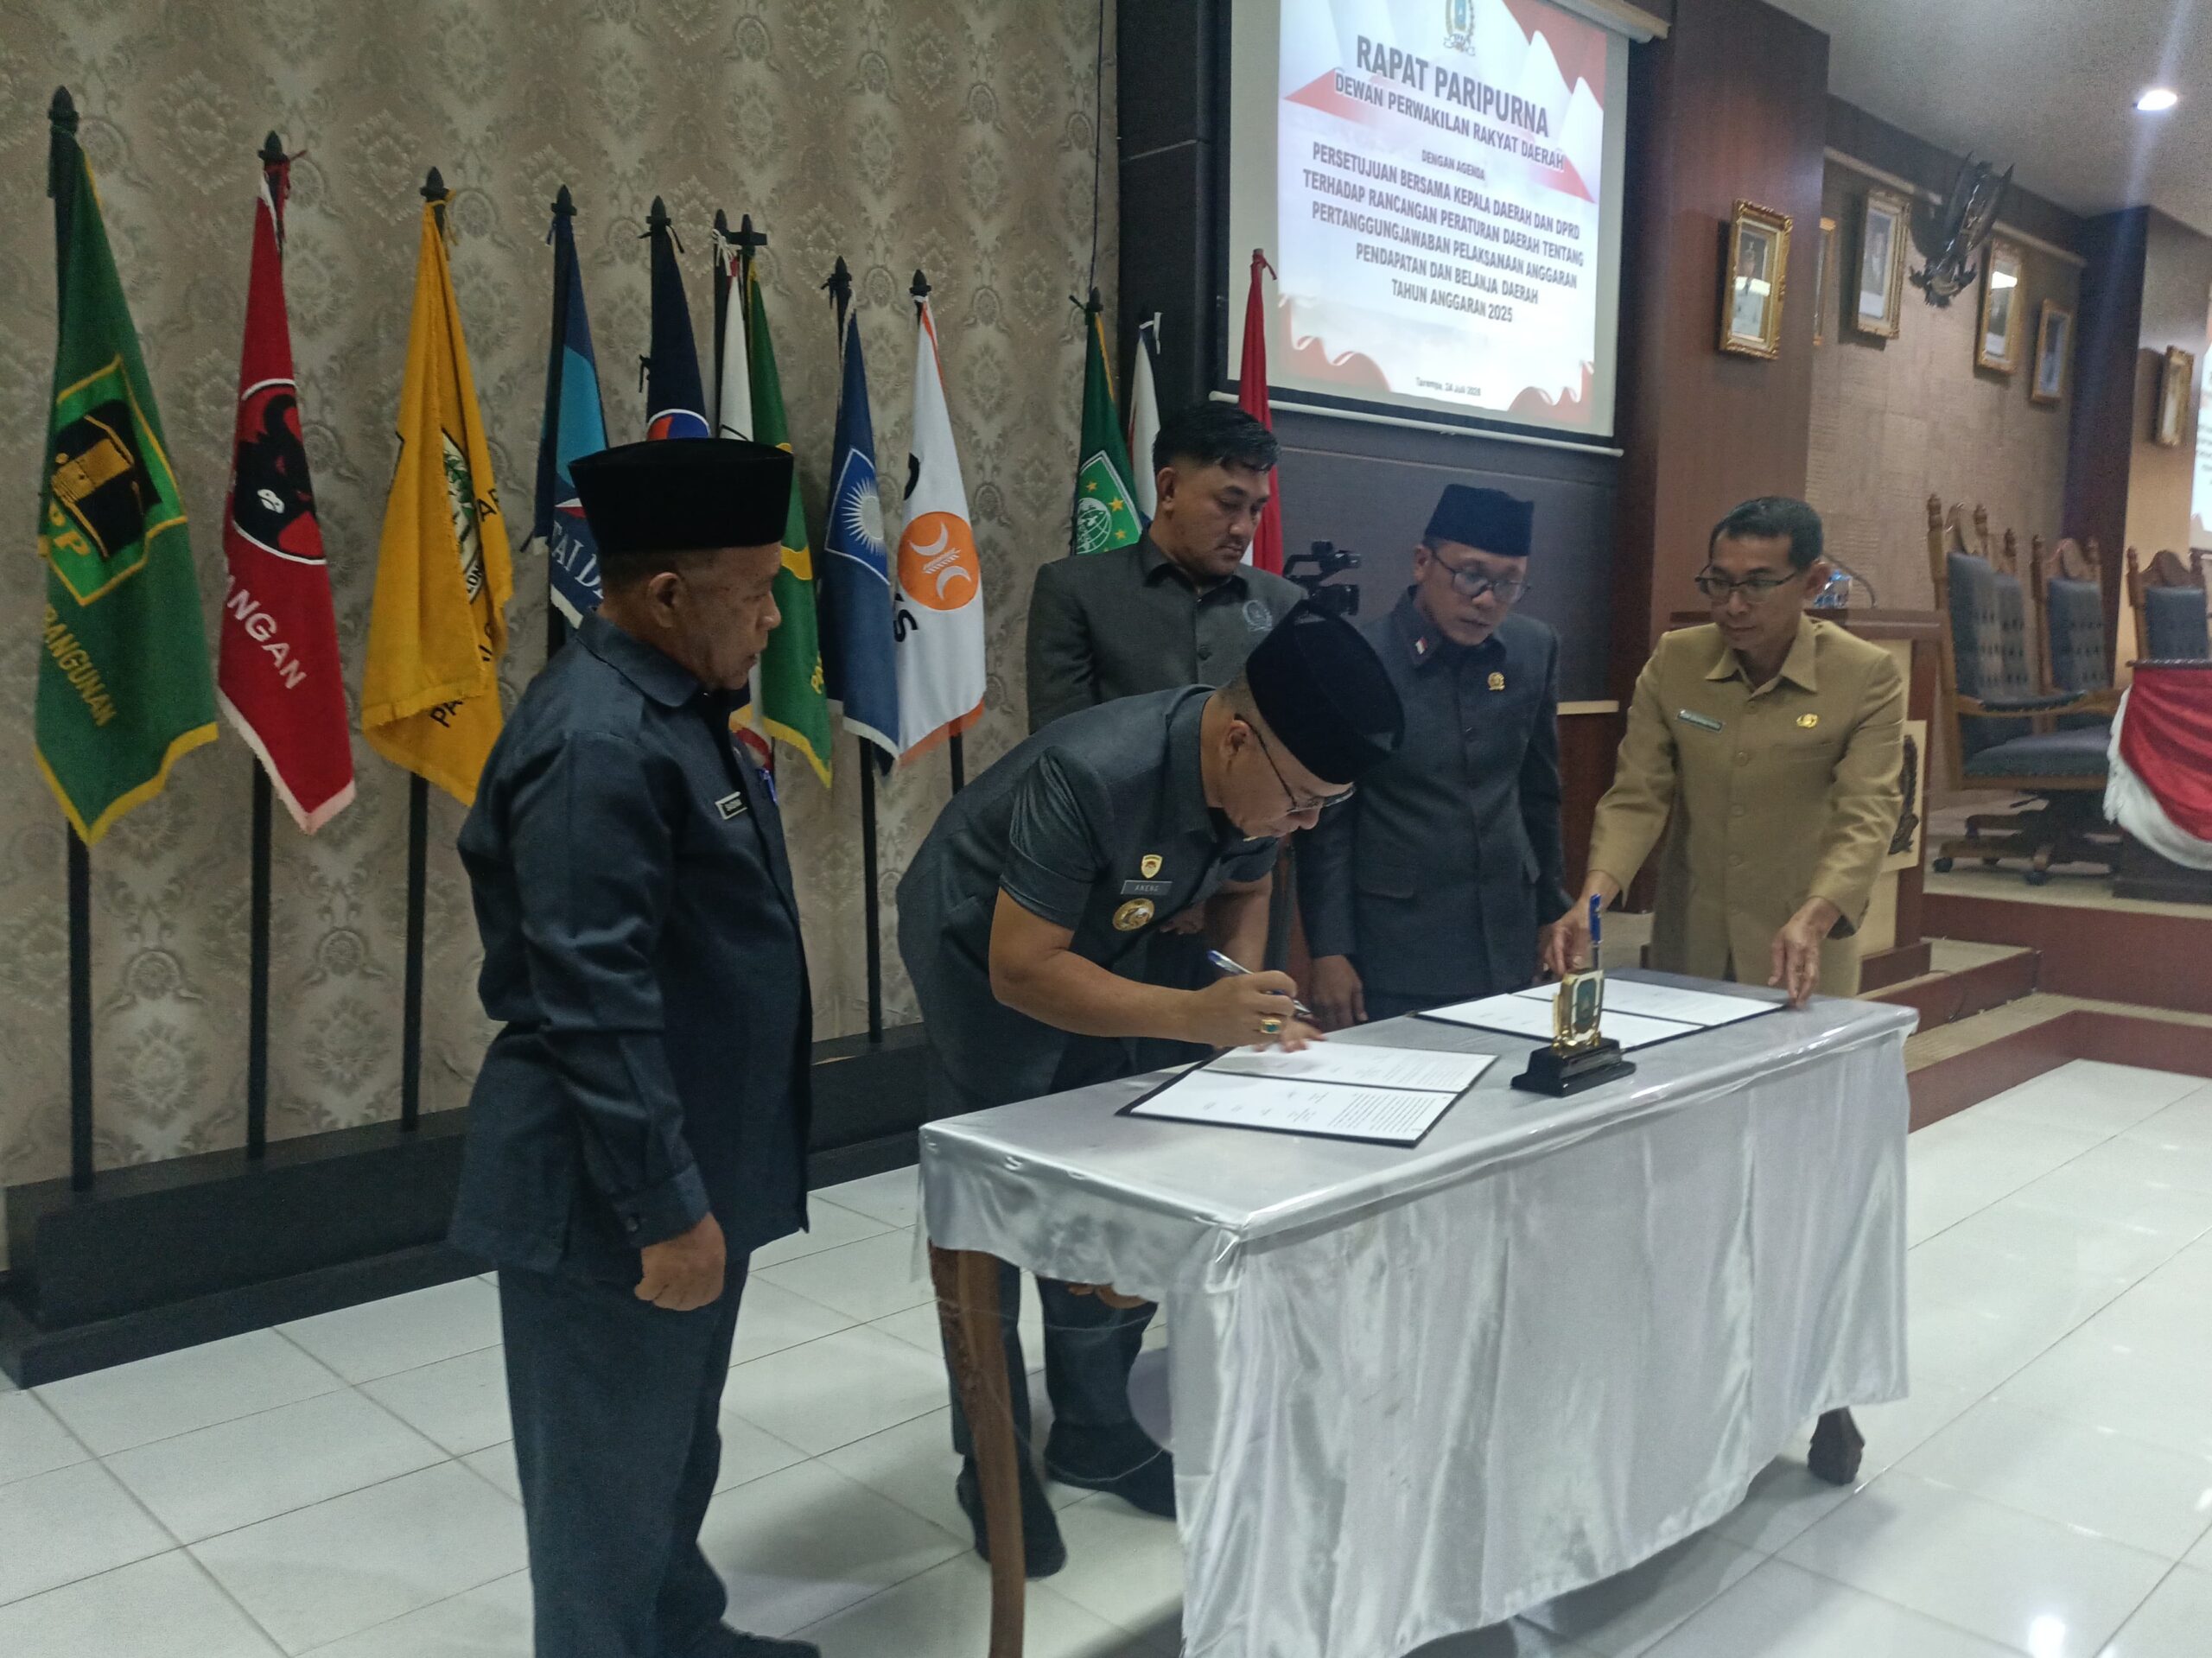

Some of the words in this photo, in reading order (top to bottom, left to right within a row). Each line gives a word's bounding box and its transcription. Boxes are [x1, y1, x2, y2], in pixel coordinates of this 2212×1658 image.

[1335, 73, 1382, 106] DEWAN
[1388, 92, 1469, 137] PERWAKILAN
[1473, 123, 1518, 152] RAKYAT
[1522, 141, 1564, 169] DAERAH
[1357, 35, 1428, 91] RAPAT
[1434, 67, 1548, 137] PARIPURNA
[1313, 141, 1397, 183] PERSETUJUAN
[1401, 168, 1451, 200] BERSAMA
[1453, 186, 1491, 213] KEPALA
[1493, 199, 1532, 226] DAERAH
[1534, 213, 1554, 232] DAN
[1556, 219, 1580, 239] DPRD
[1421, 149, 1455, 168] DENGAN
[1457, 159, 1485, 180] AGENDA
[1303, 168, 1365, 202] TERHADAP
[1369, 188, 1437, 225] RANCANGAN
[1440, 209, 1500, 243] PERATURAN
[1503, 228, 1540, 254] DAERAH
[1542, 240, 1584, 267] TENTANG
[1312, 200, 1451, 254] PERTANGGUNGJAWABAN
[1453, 240, 1524, 274] PELAKSANAAN
[1526, 262, 1577, 289] ANGGARAN
[1356, 242, 1426, 276] PENDAPATAN
[1430, 262, 1452, 282] DAN
[1455, 268, 1498, 294] BELANJA
[1502, 280, 1538, 304] DAERAH
[1391, 278, 1427, 303] TAHUN
[1430, 289, 1486, 316] ANGGARAN
[1488, 303, 1513, 322] 2025
